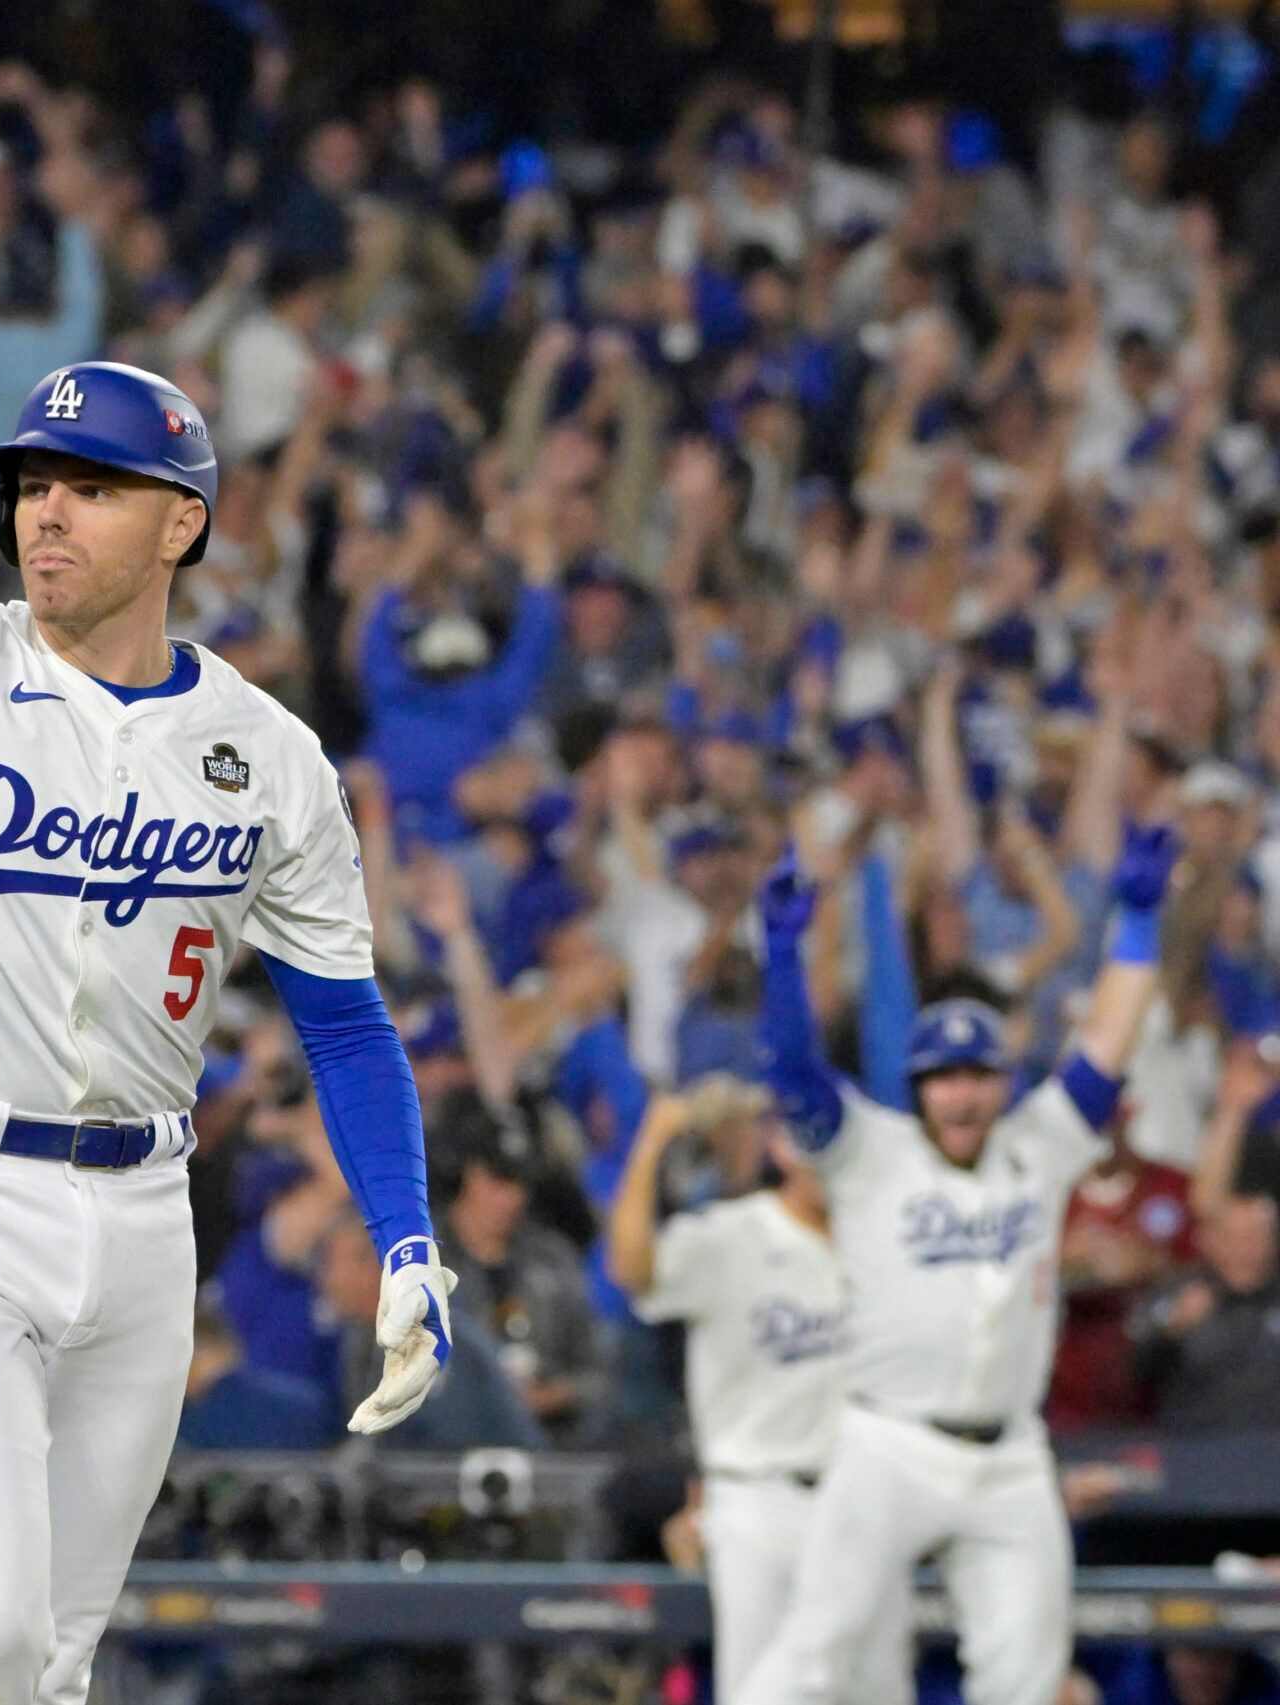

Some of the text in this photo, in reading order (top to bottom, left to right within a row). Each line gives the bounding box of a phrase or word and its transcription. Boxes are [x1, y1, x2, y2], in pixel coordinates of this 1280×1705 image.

[45, 371, 84, 419] LA
[206, 759, 247, 774] WORLD
[209, 768, 245, 783] SERIES
[162, 925, 214, 1021] 5
